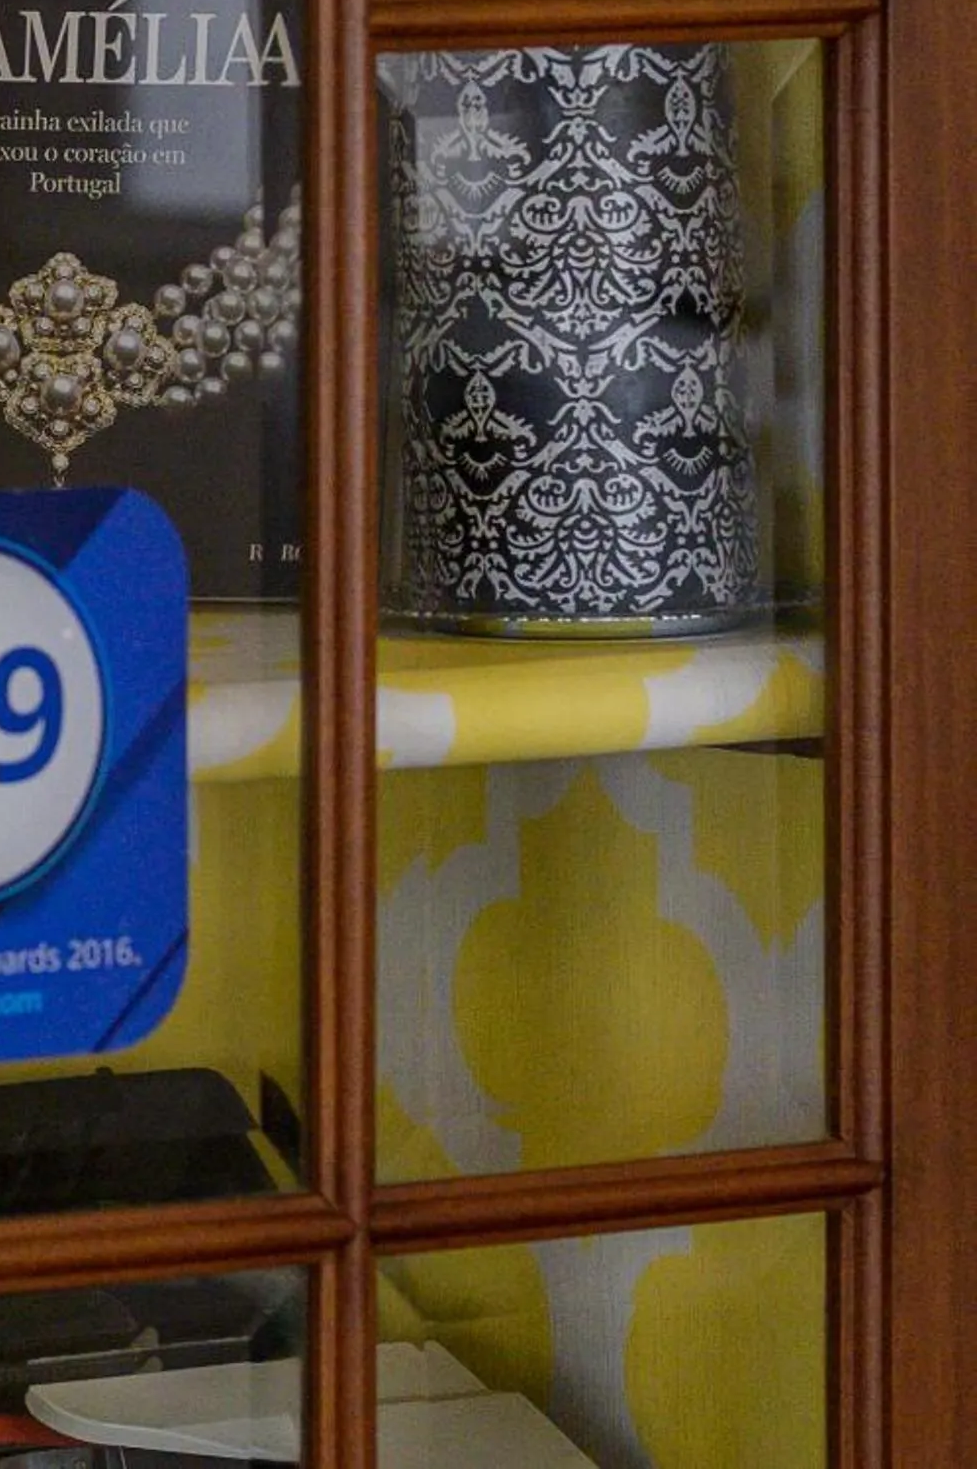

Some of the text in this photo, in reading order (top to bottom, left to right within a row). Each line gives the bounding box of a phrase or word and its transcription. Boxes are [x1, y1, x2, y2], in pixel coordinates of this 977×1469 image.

[67, 110, 143, 133] exilada
[149, 119, 190, 139] que
[44, 146, 58, 162] o
[63, 142, 146, 168] coração
[152, 149, 185, 165] em
[30, 171, 122, 199] Portugal
